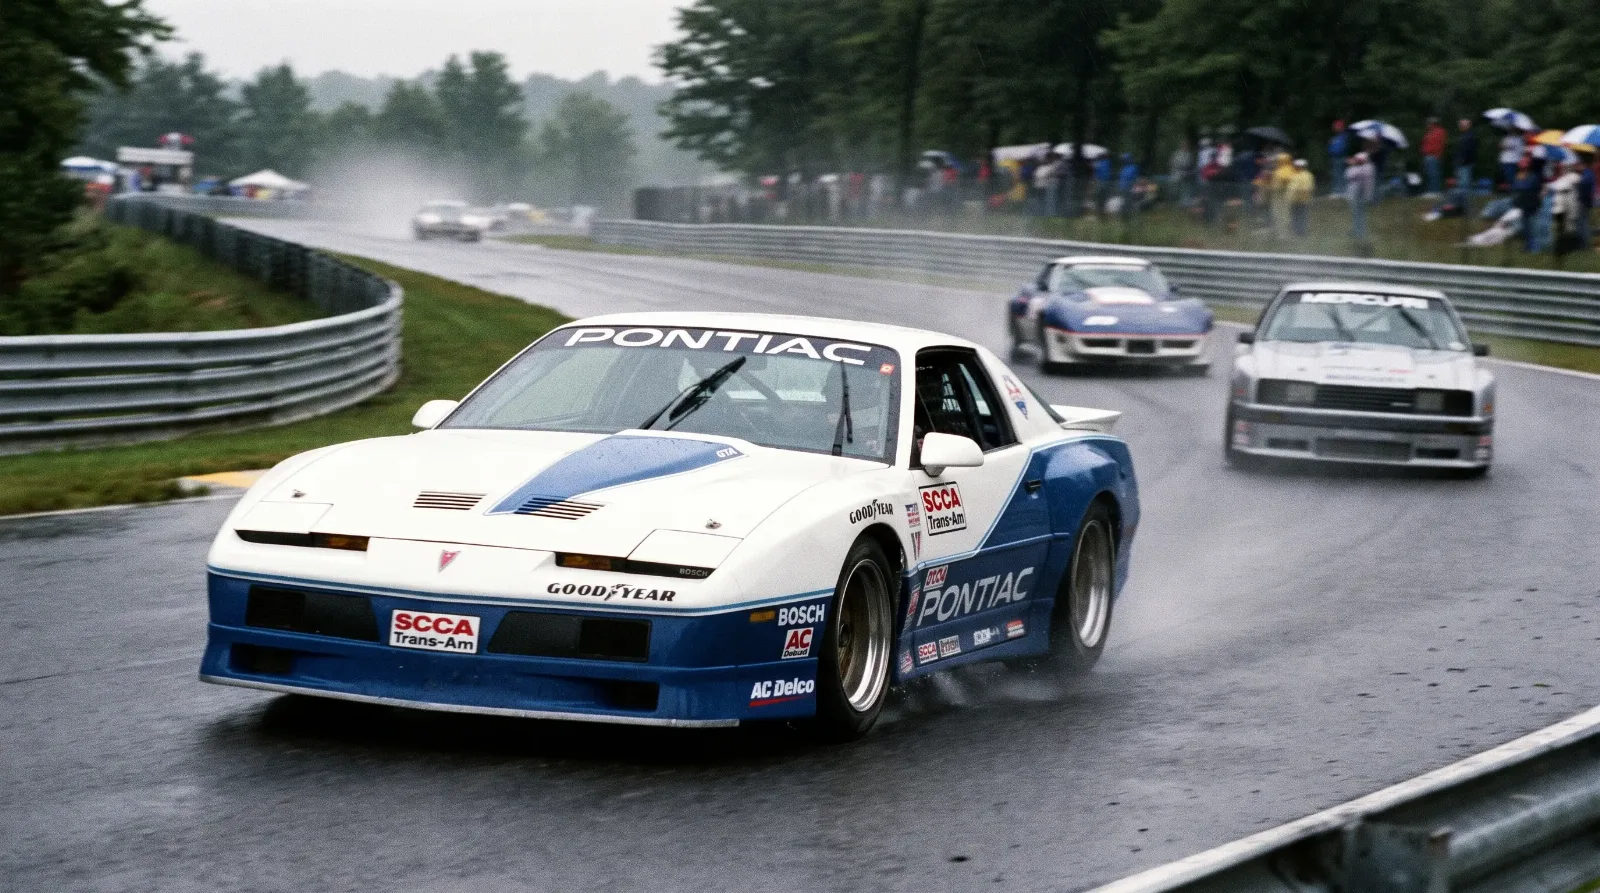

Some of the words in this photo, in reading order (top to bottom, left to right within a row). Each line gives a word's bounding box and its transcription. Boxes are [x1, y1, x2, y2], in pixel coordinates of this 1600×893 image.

[563, 328, 872, 366] PONTIAC
[716, 447, 738, 458] GTA
[922, 488, 961, 512] SCCA
[849, 499, 894, 525] GOODYEAR
[679, 568, 708, 577] BOSCH
[547, 583, 676, 602] GOODYEAR
[916, 567, 1035, 627] PONTIAC
[395, 612, 474, 637] SCCA
[778, 604, 825, 626] BOSCH
[393, 631, 474, 651] Trans-Am
[785, 628, 811, 650] AC
[919, 643, 937, 657] SCCA
[750, 681, 772, 700] AC
[773, 677, 815, 697] Delco
